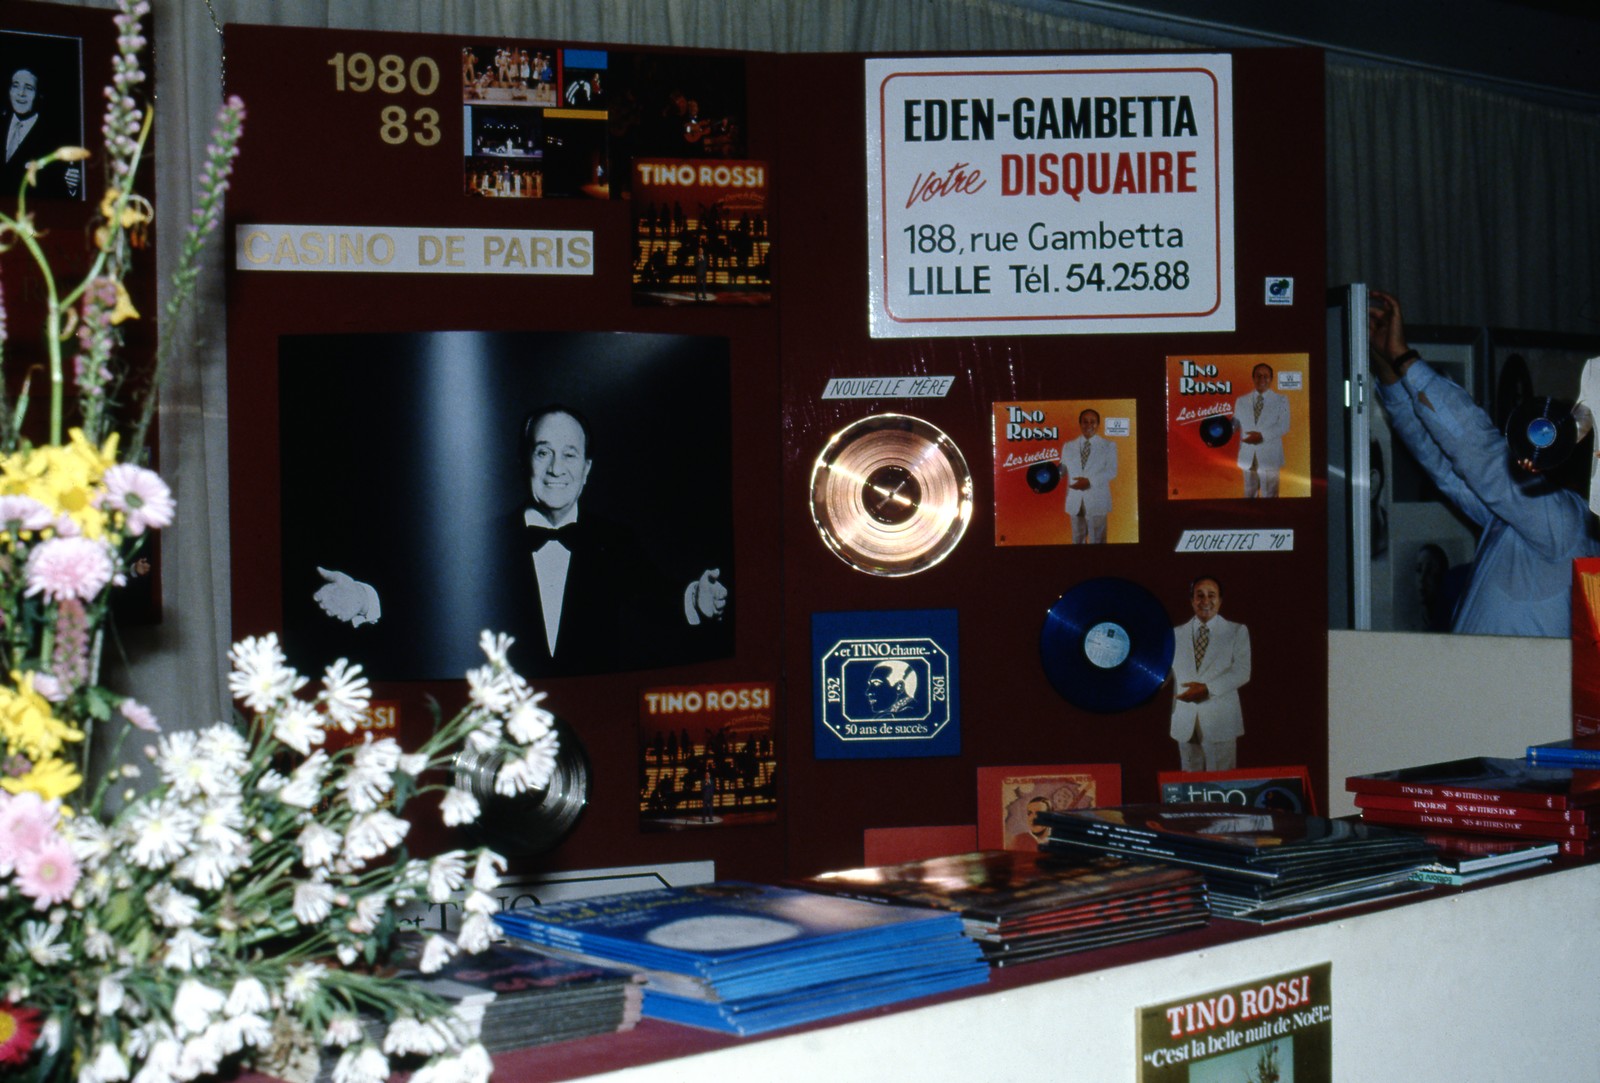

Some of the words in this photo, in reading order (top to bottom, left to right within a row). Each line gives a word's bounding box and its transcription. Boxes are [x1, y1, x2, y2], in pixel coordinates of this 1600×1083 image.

[327, 51, 440, 96] 1980
[380, 105, 442, 147] 83
[904, 95, 1198, 142] EDEN-GAMBETTA
[637, 162, 696, 187] TINO
[699, 165, 765, 189] ROSSI
[905, 162, 987, 209] Votre
[1000, 151, 1198, 202] DISQUAIRE
[242, 231, 396, 266] CASINO
[418, 234, 467, 267] DE
[483, 236, 592, 269] PARIS
[903, 223, 964, 255] 188,
[969, 229, 1019, 253] rue
[1028, 221, 1183, 251] Gambetta
[907, 265, 991, 296] LILLE
[1009, 262, 1060, 293] Tél.
[1066, 260, 1190, 293] 54.25.88
[829, 379, 905, 397] NOUVELLE
[908, 376, 950, 396] MÈRE
[1175, 407, 1197, 422] Les
[1198, 402, 1233, 417] inédits
[1003, 453, 1023, 468] Les
[1024, 448, 1060, 463] inédits
[1185, 533, 1260, 551] POCHETTES
[840, 647, 850, 657] et
[851, 643, 891, 657] TINO
[644, 691, 704, 715] TINO
[705, 688, 771, 713] ROSSI
[827, 677, 841, 703] 1932
[932, 675, 946, 702] 1982
[845, 724, 858, 735] 50
[859, 725, 878, 735] ans
[879, 724, 893, 734] de
[895, 722, 929, 734] succès
[1166, 993, 1236, 1039] TINO
[1240, 974, 1312, 1020] ROSSI
[1191, 1040, 1207, 1058] la
[1208, 1028, 1244, 1054] belle
[1245, 1023, 1272, 1044] nuit
[1273, 1016, 1291, 1036] de
